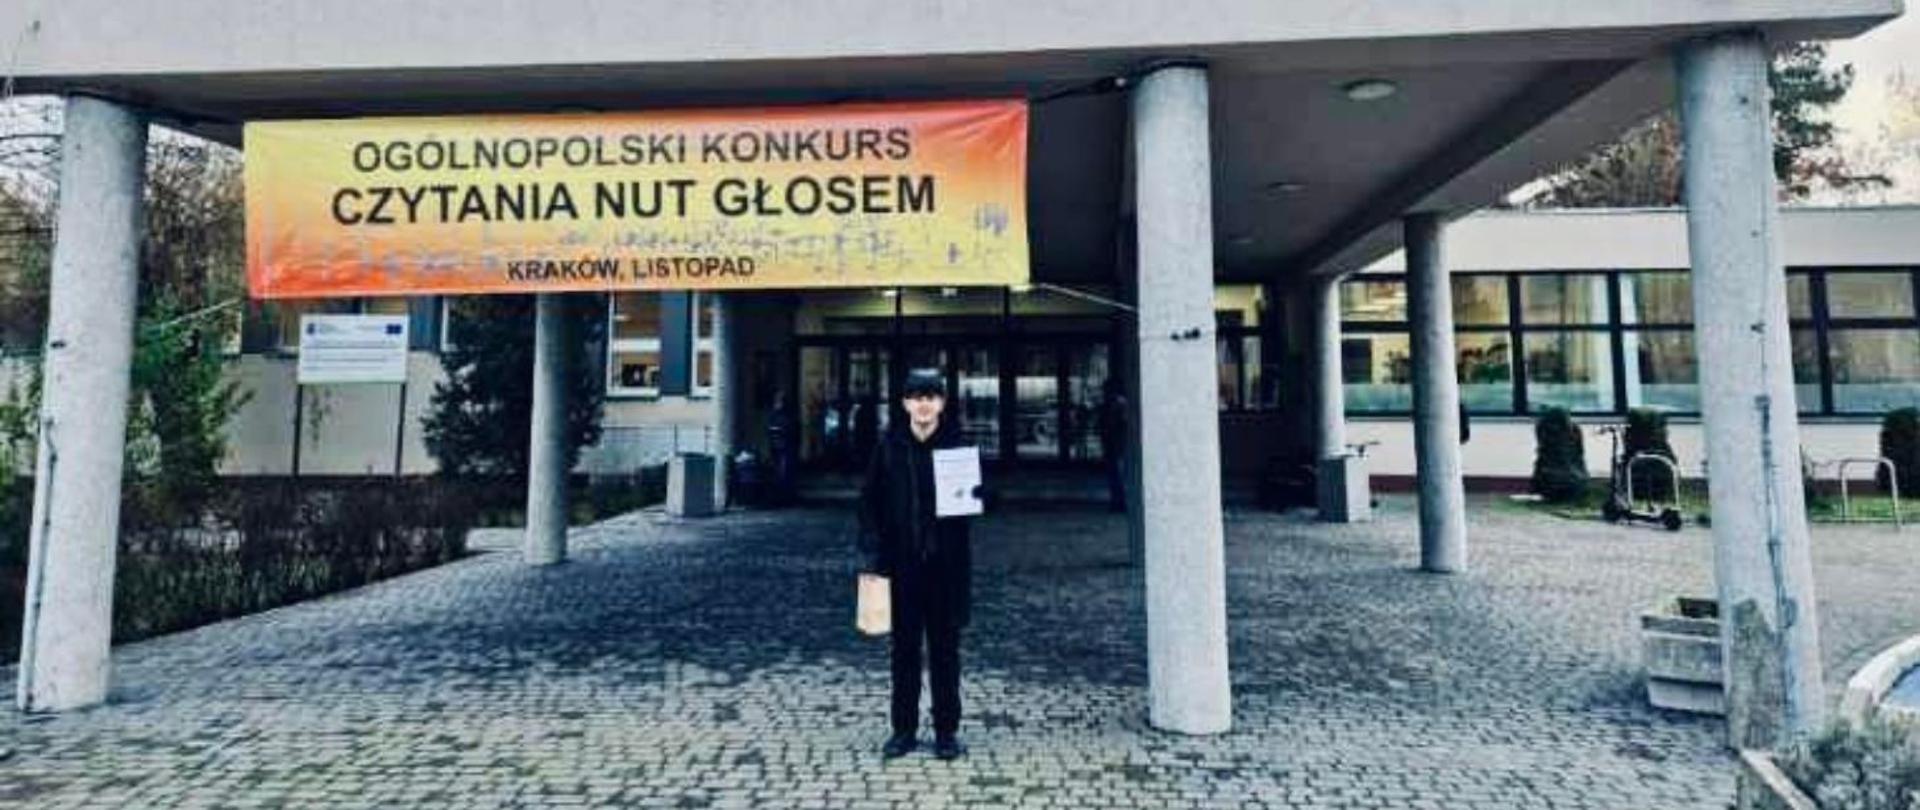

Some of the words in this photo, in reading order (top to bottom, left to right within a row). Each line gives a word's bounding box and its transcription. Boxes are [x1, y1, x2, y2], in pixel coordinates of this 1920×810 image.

[353, 132, 686, 172] OGÓLNOPOLSKI
[701, 128, 912, 163] KONKURS
[331, 182, 578, 225] CZYTANIA
[595, 179, 696, 219] NUT
[713, 174, 936, 217] GŁOSEM
[632, 256, 756, 278] LISTOPAD
